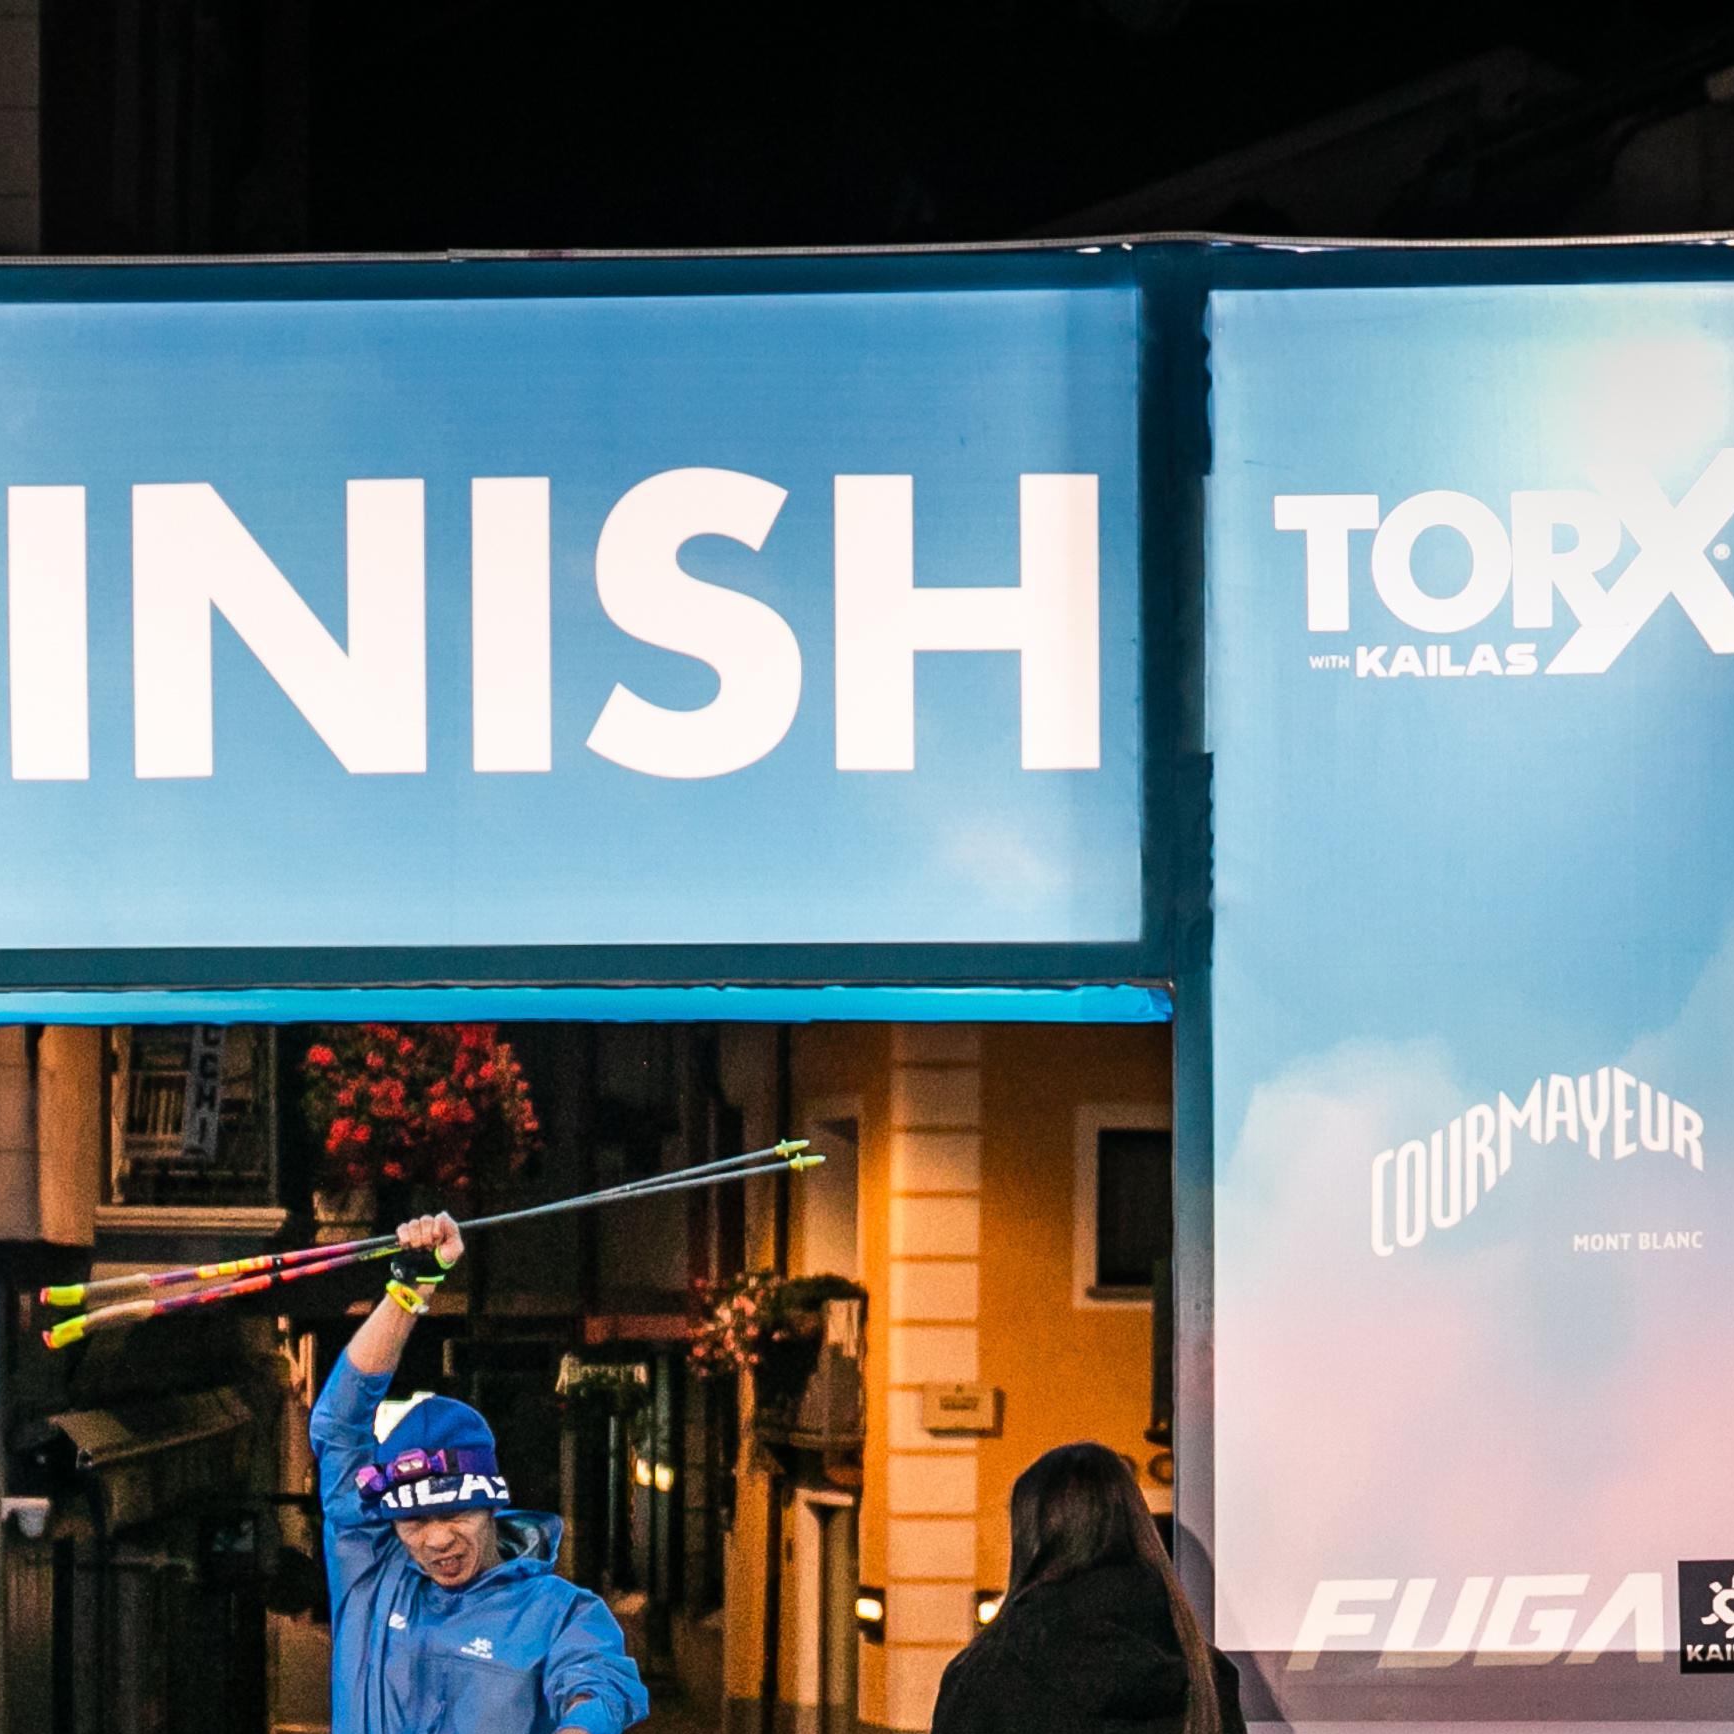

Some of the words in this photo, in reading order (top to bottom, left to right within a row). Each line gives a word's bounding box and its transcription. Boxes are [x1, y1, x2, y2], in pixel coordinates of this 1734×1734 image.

[1309, 654, 1350, 670] WITH
[1356, 643, 1539, 678] KAILAS
[1370, 1066, 1705, 1258] COURMAYEUR
[1573, 1233, 1631, 1253] MONT
[1638, 1231, 1704, 1251] BLANC
[1284, 1572, 1665, 1672] FUGA
